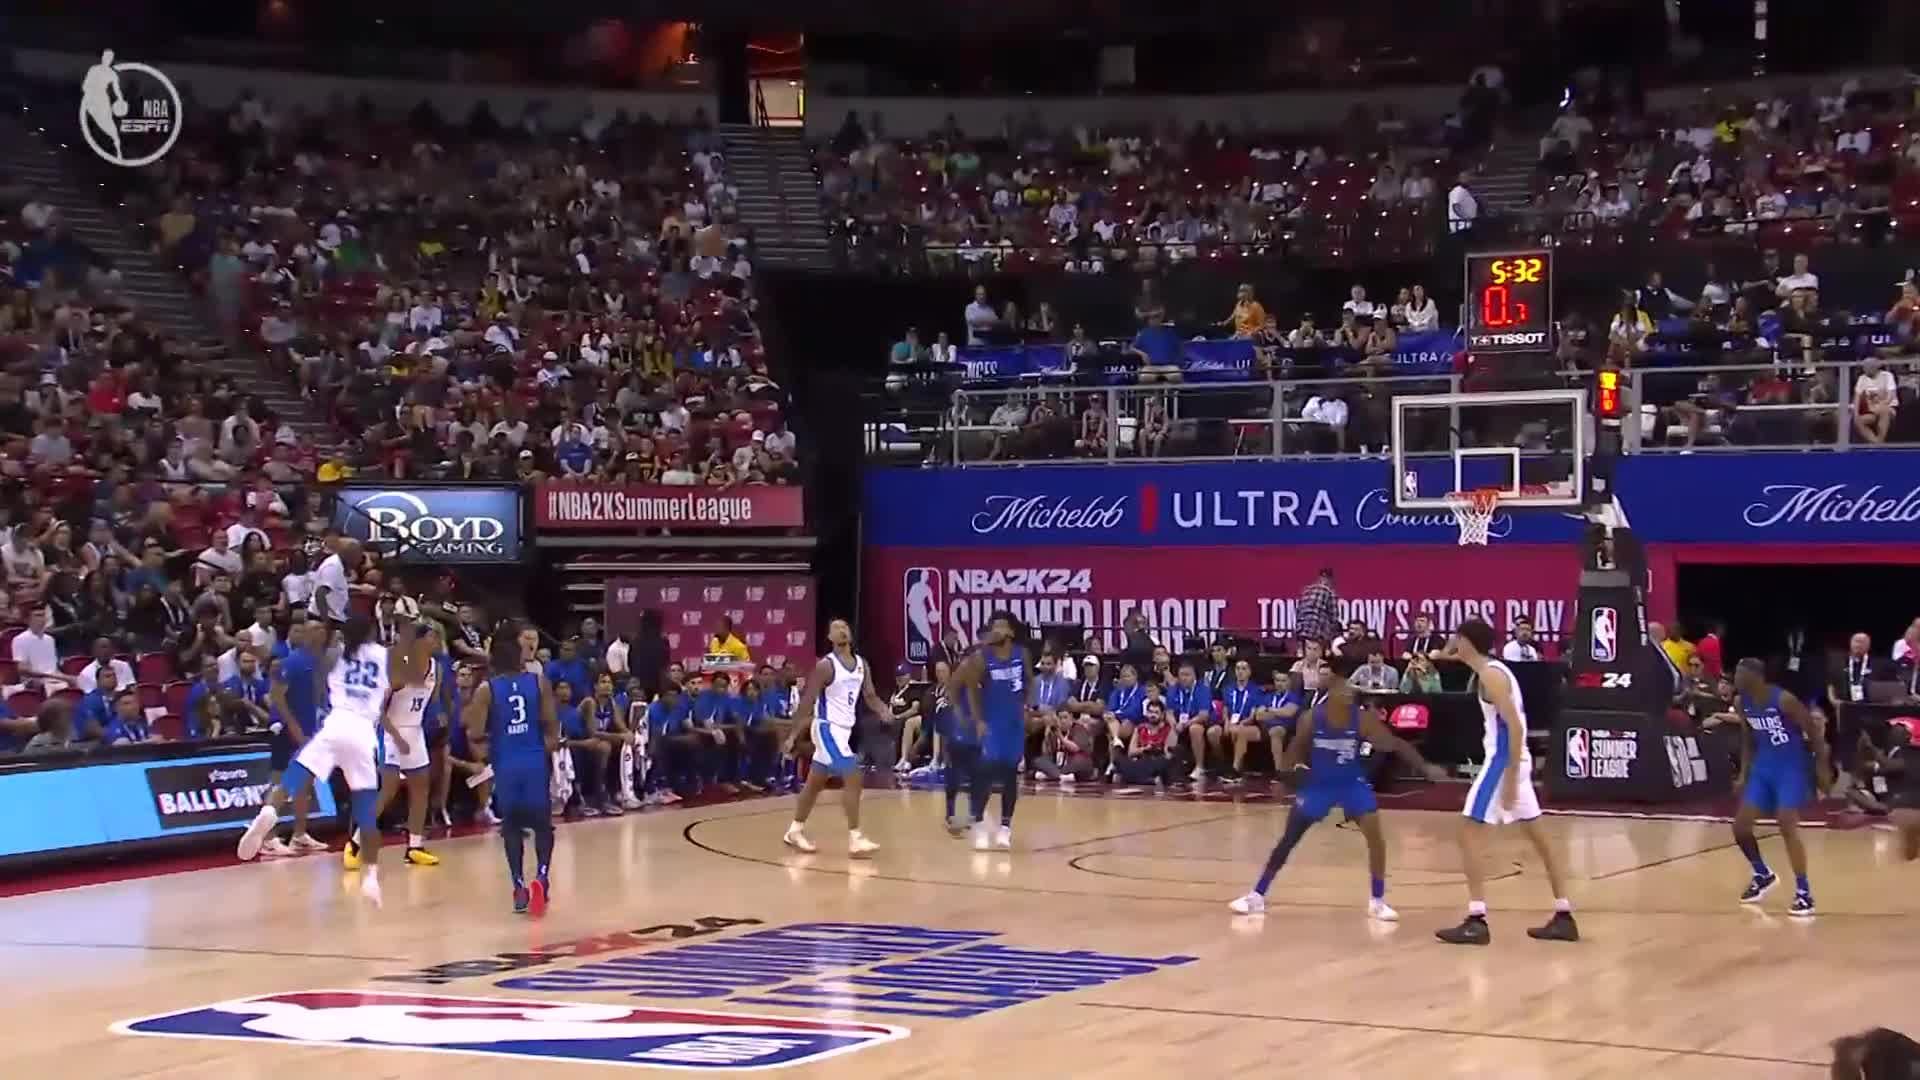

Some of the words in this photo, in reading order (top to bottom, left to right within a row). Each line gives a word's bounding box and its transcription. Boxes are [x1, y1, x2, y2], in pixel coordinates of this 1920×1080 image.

[1491, 259, 1542, 284] 5:32
[1484, 286, 1527, 325] 0.7
[1491, 332, 1546, 345] TISSOT
[548, 491, 751, 525] #NBA2KSummerLeague
[971, 495, 1128, 533] Michelob
[1173, 489, 1340, 527] ULTRA
[1743, 484, 1920, 526] Michelo
[416, 542, 504, 554] GAMING
[948, 569, 1092, 594] NBA2K24
[508, 695, 526, 724] 3
[1769, 729, 1790, 746] 26
[1592, 759, 1629, 779] LEAGUE
[158, 788, 216, 814] BALL
